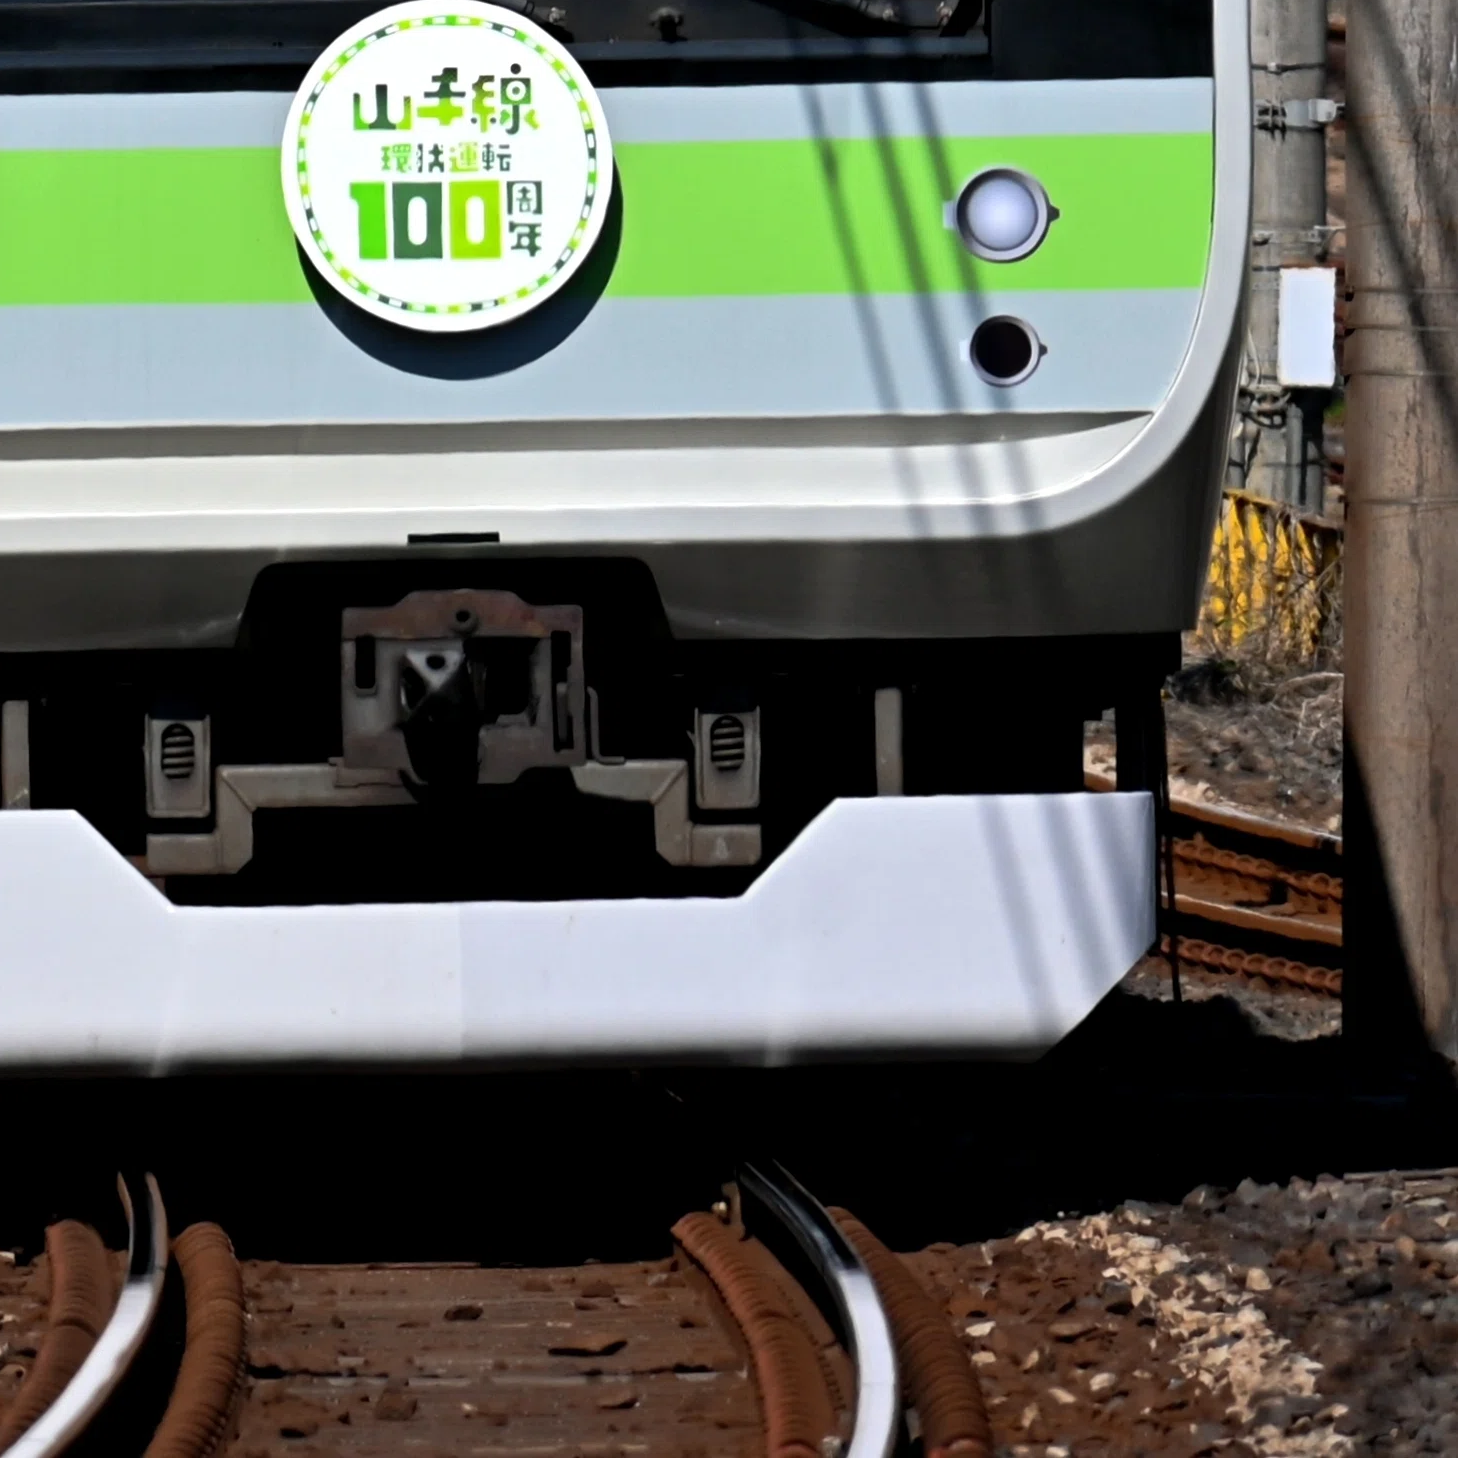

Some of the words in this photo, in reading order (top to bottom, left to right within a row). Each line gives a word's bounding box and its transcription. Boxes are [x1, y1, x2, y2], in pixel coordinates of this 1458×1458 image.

[352, 63, 541, 135] 山手線
[349, 180, 502, 260] 100
[506, 180, 544, 257] 周年
